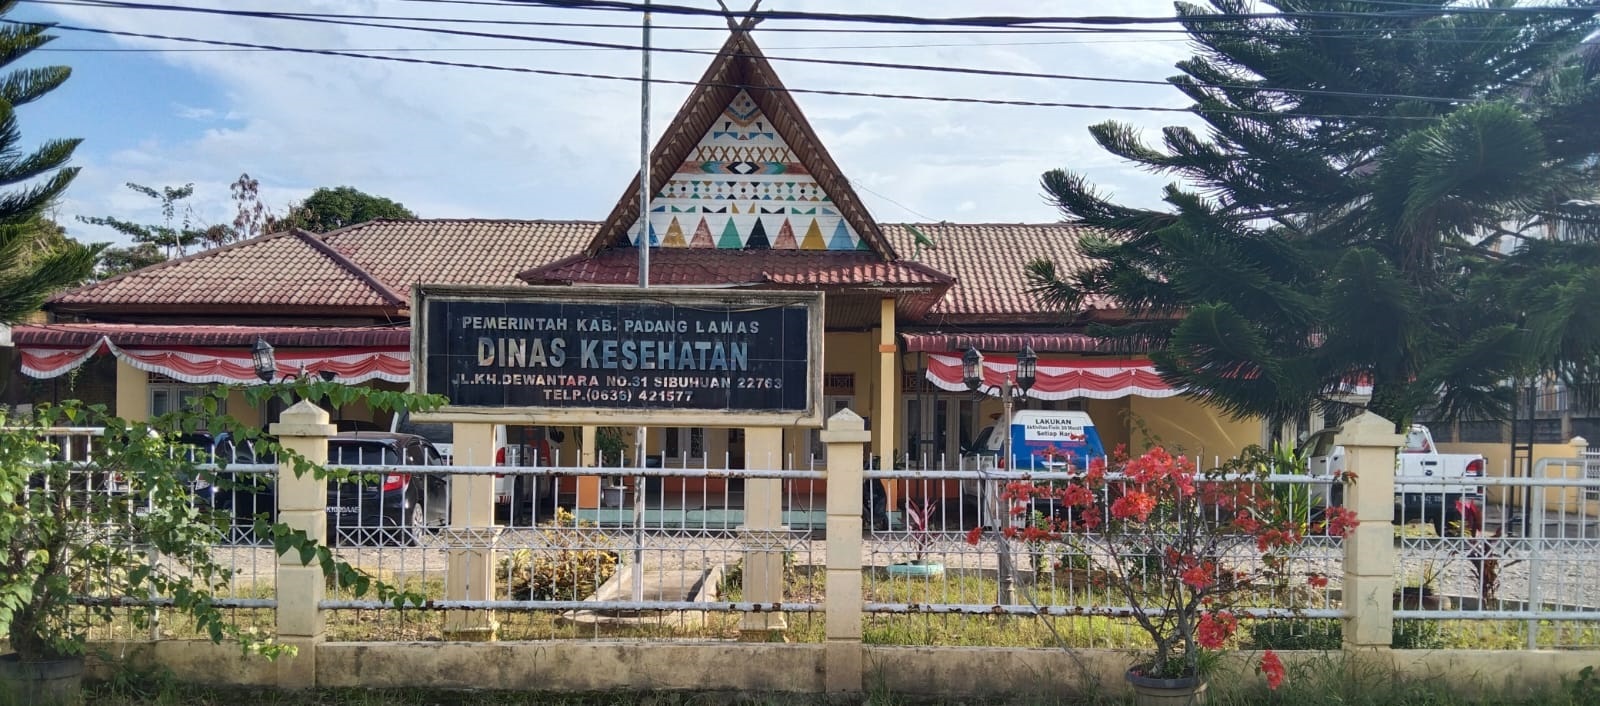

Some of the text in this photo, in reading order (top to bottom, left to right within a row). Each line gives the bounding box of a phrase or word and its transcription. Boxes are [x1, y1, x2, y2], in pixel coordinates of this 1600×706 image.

[462, 316, 760, 334] PEMERINTAH KAB. PADANG LAWAS
[478, 337, 748, 371] DINAS KESEHATAN
[452, 373, 783, 389] JL.KH.DEWANTARA NO.31 SIBUHUAN 22763
[543, 388, 694, 402] TELP.(0636) 421577
